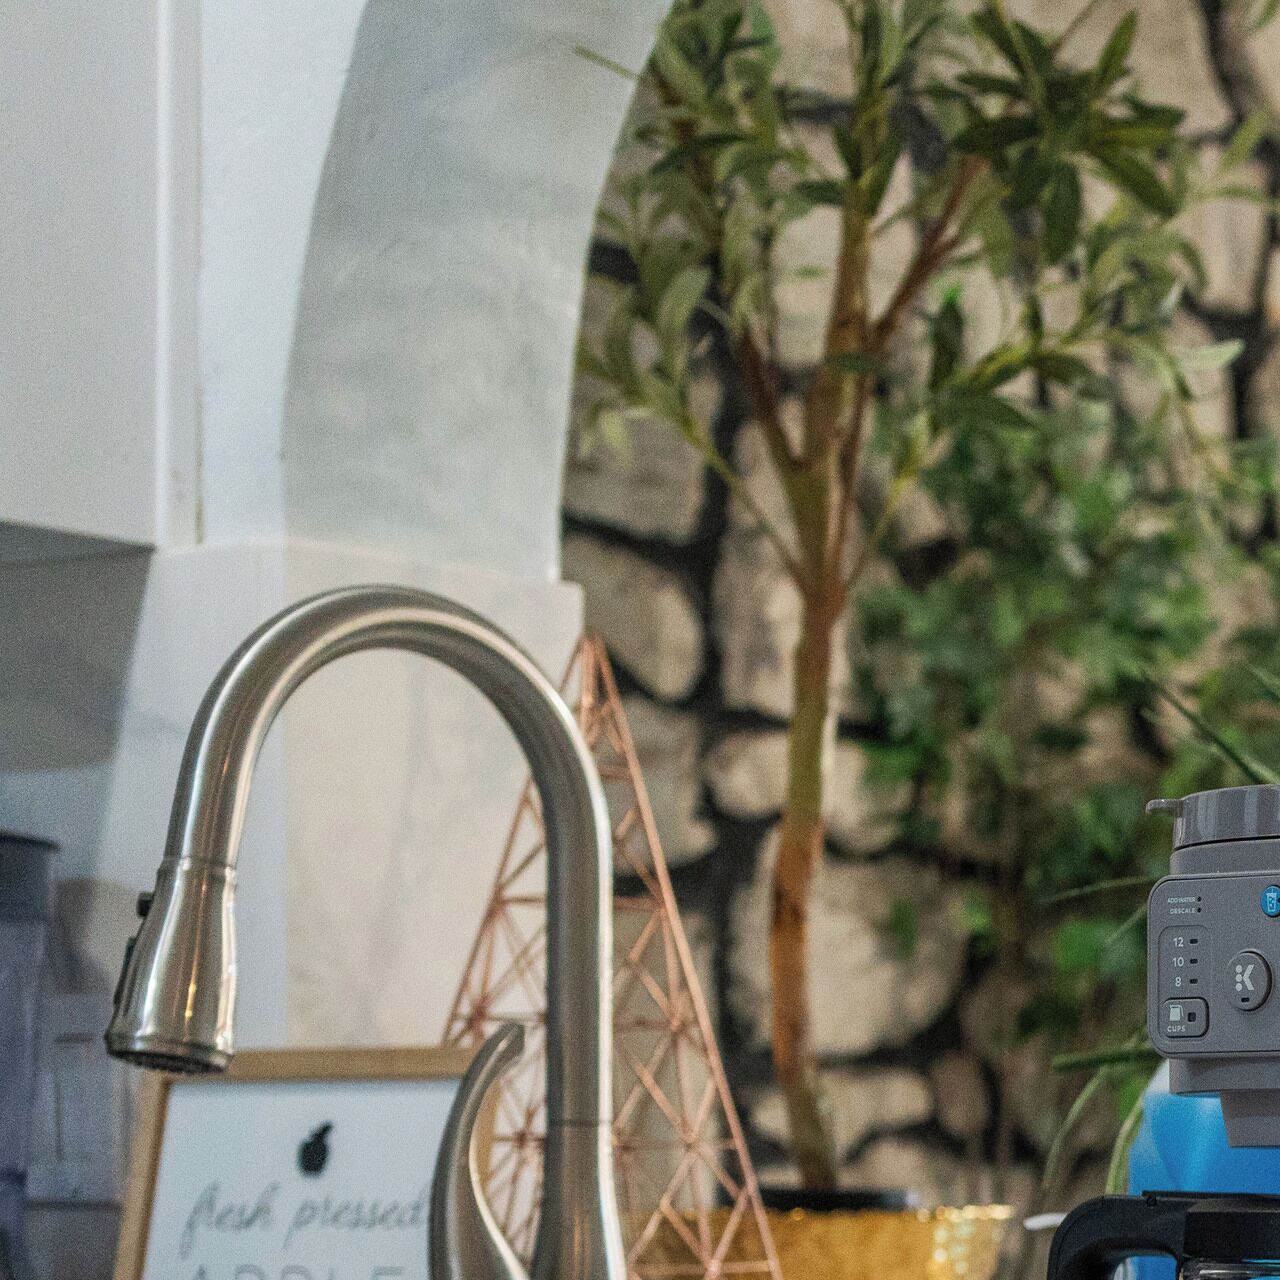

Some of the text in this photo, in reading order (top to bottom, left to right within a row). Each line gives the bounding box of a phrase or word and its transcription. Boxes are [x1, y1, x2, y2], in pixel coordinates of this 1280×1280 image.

[1173, 937, 1185, 948] 12
[1172, 956, 1185, 968] 10
[1174, 976, 1183, 988] 8
[1166, 1024, 1187, 1033] CUPS
